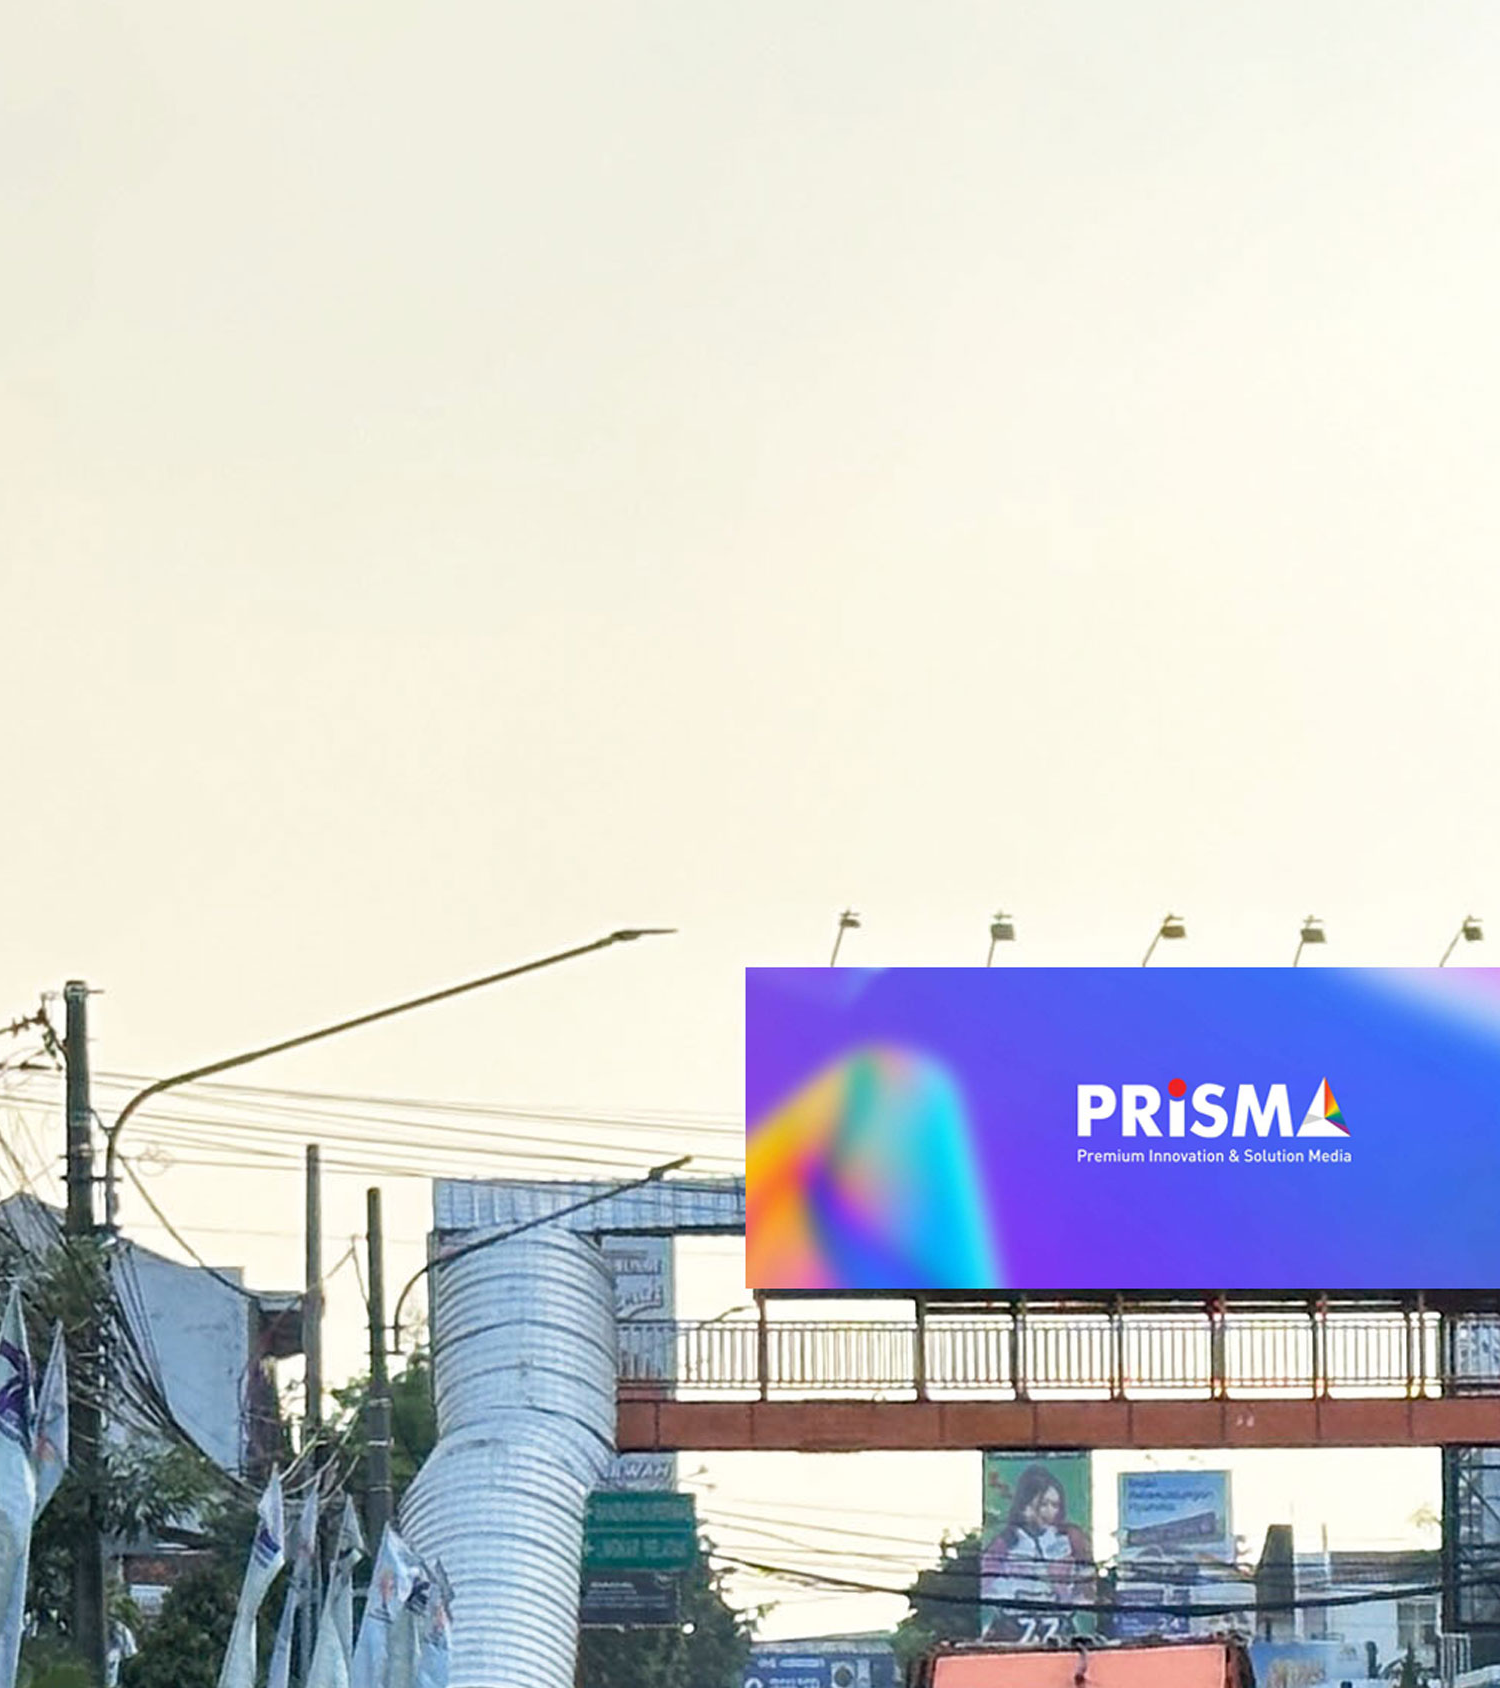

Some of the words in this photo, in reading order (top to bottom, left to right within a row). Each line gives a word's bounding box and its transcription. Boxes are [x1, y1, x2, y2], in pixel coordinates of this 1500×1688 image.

[1077, 1149, 1145, 1162] Premium
[1149, 1149, 1224, 1162] Innovation
[1229, 1149, 1239, 1162] &
[1244, 1149, 1304, 1162] Solution
[1308, 1149, 1352, 1162] Media
